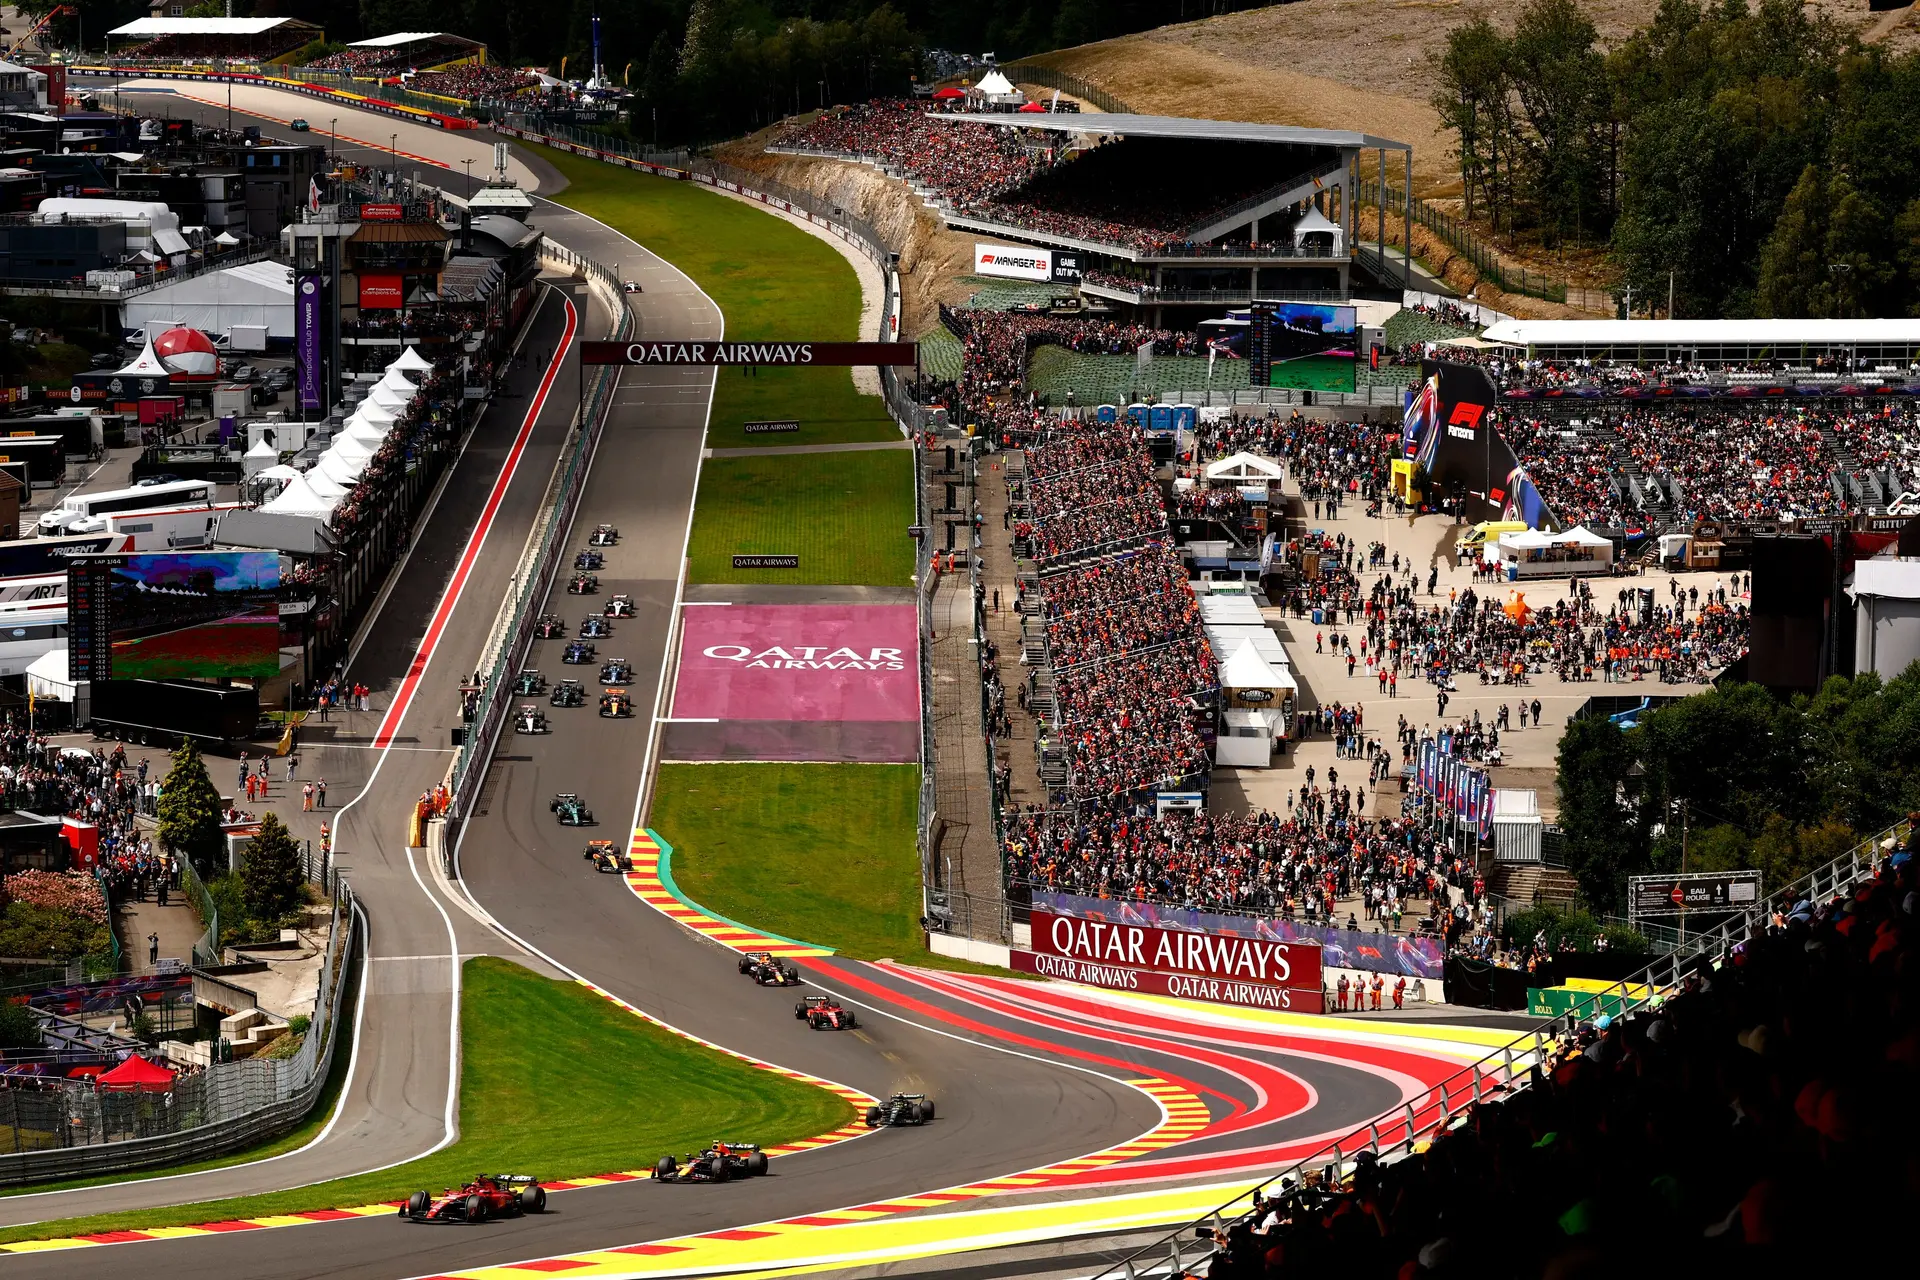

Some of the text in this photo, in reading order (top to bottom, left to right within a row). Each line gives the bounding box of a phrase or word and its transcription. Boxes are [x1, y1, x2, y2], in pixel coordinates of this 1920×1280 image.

[576, 112, 597, 120] PMR
[994, 256, 1036, 269] MANAGER
[1036, 260, 1047, 270] 23
[1060, 258, 1076, 267] GAME
[1056, 267, 1067, 276] OUT
[626, 344, 813, 364] QATAR AIRWAYS
[746, 423, 798, 432] QATAR AIRWAYS
[763, 558, 796, 566] AIRWAYS
[25, 584, 62, 600] ART
[703, 645, 904, 661] QATAR
[745, 660, 904, 670] AIRWAYS
[1051, 917, 1290, 981] QATAR AIRWAYS
[1035, 955, 1138, 989] QATAR AIRWAYS
[1167, 976, 1291, 1008] QATAR AIRWAYS
[1534, 1005, 1553, 1015] ROLEX
